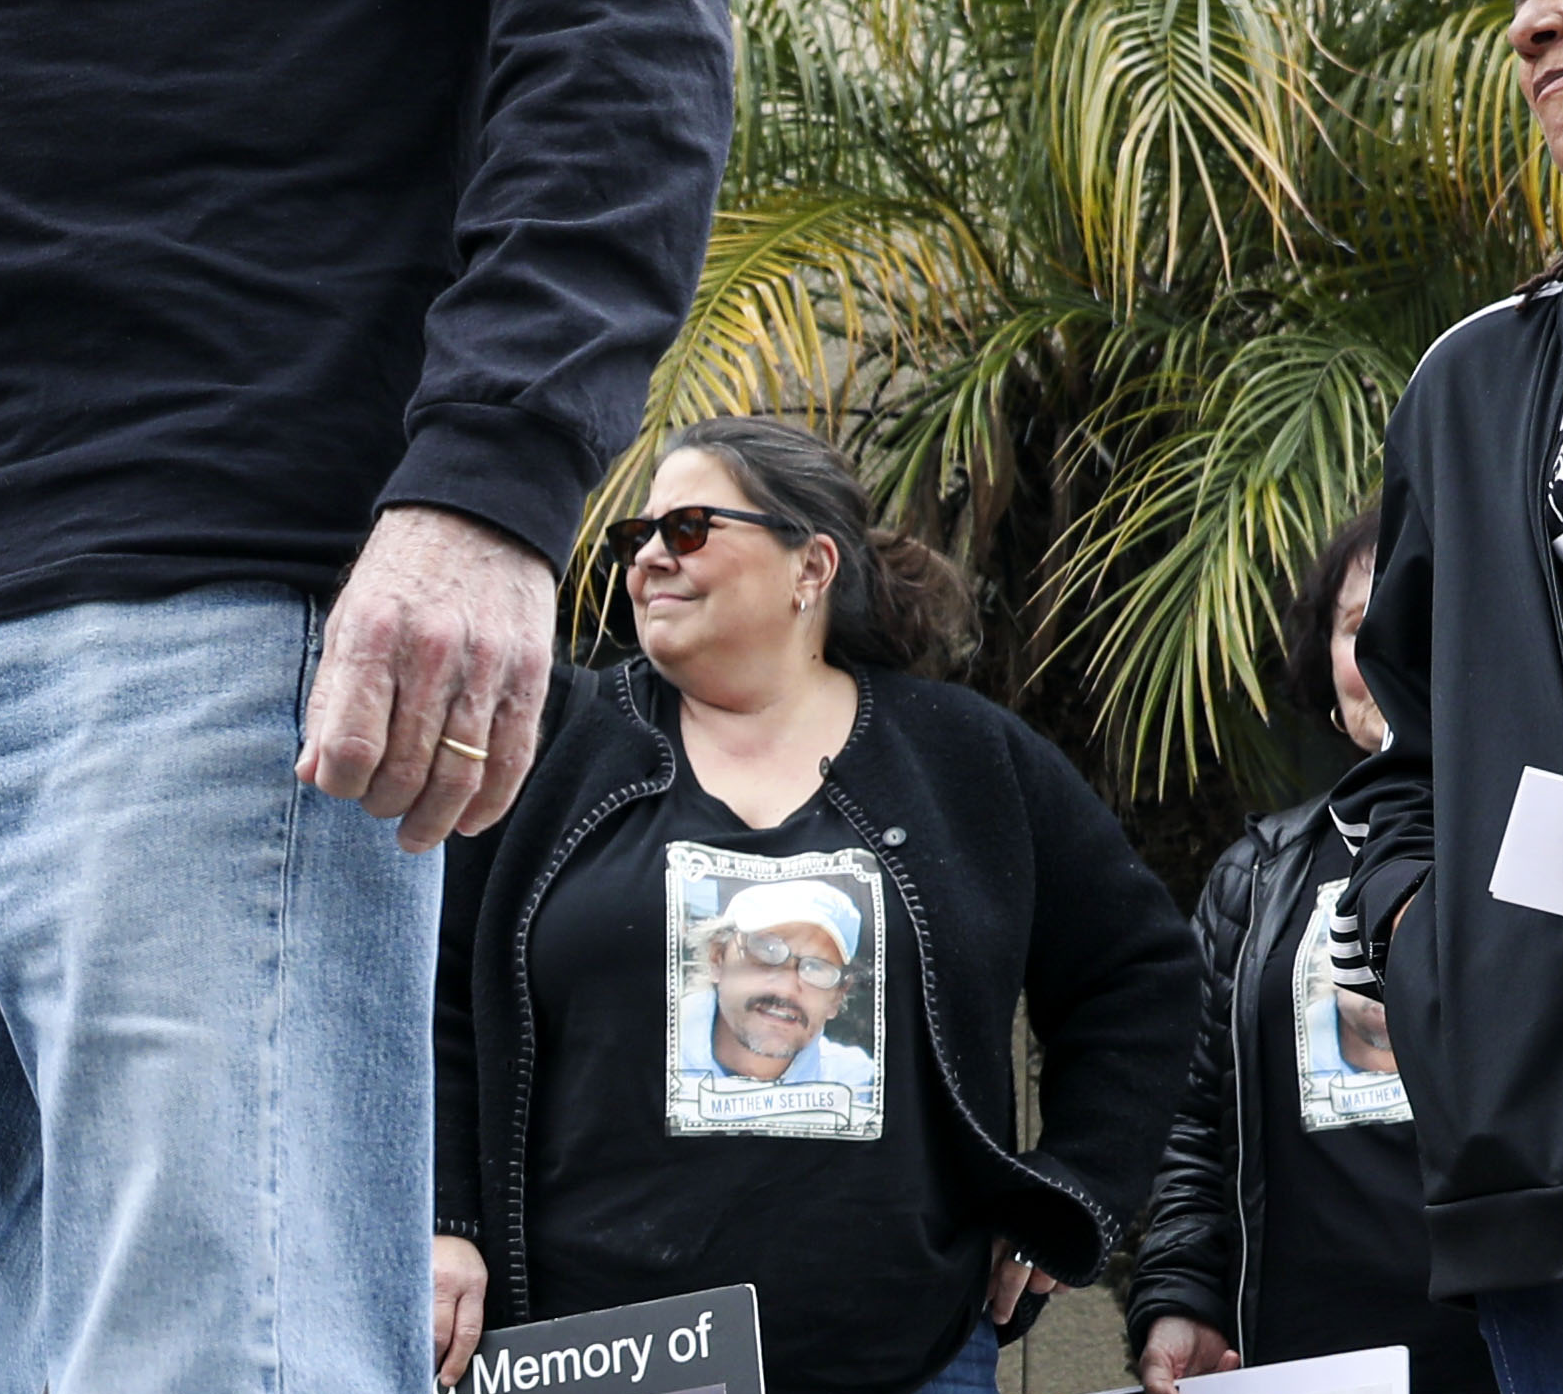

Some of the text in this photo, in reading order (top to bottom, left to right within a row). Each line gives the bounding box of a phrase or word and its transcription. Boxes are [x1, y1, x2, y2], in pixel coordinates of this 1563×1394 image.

[711, 1091, 834, 1115] MATTHEW SETTLES
[1341, 1086, 1401, 1109] MATTHEW
[668, 1311, 714, 1364] of
